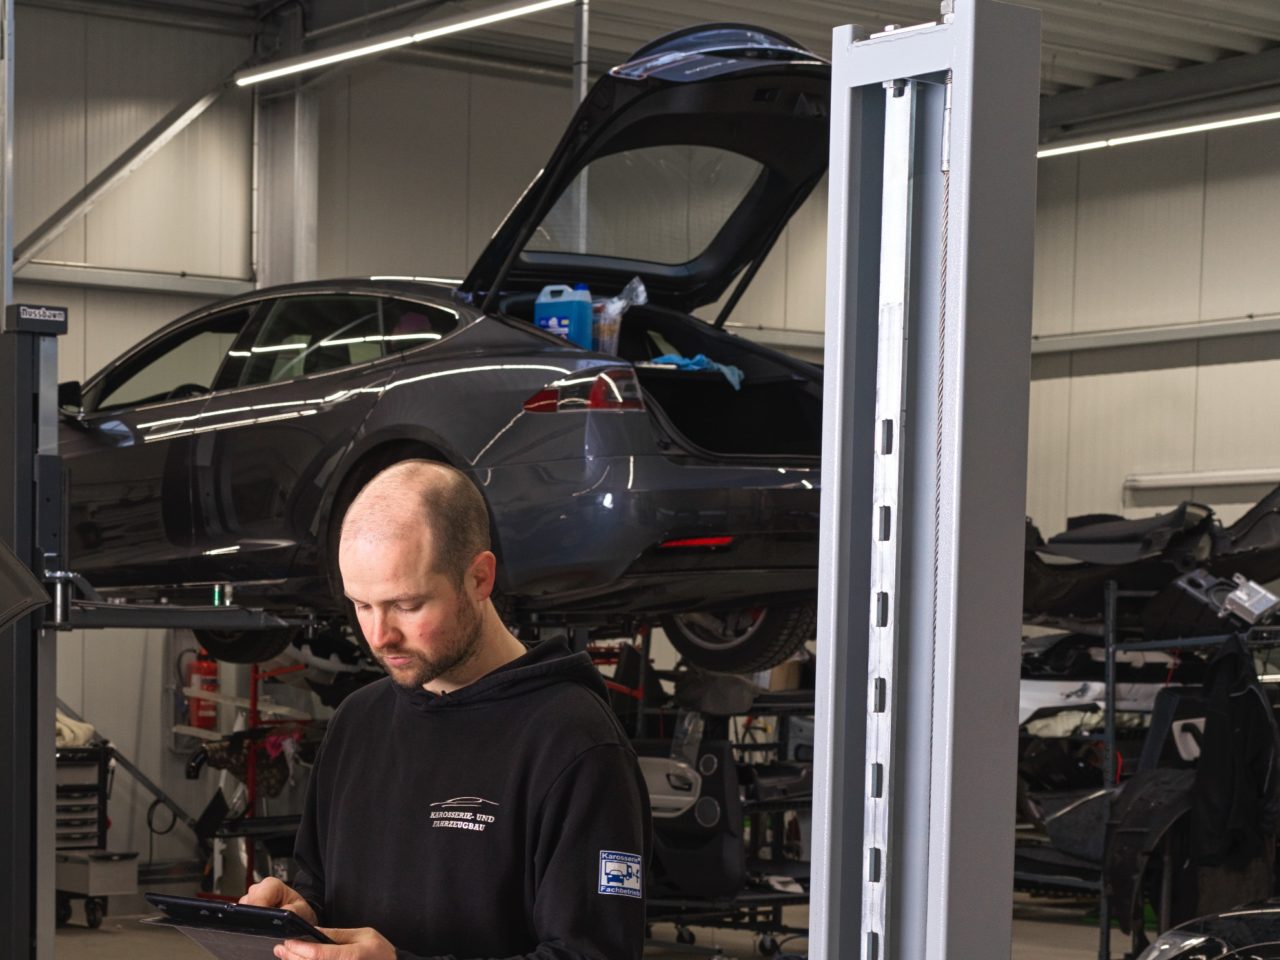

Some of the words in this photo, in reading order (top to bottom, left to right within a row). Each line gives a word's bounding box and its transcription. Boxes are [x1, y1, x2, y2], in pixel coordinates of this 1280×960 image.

[429, 811, 475, 820] KAROSSERIE-
[476, 813, 495, 823] UND
[431, 819, 486, 832] FAHRZEUGBAU
[600, 885, 640, 897] Fachbetrieb
